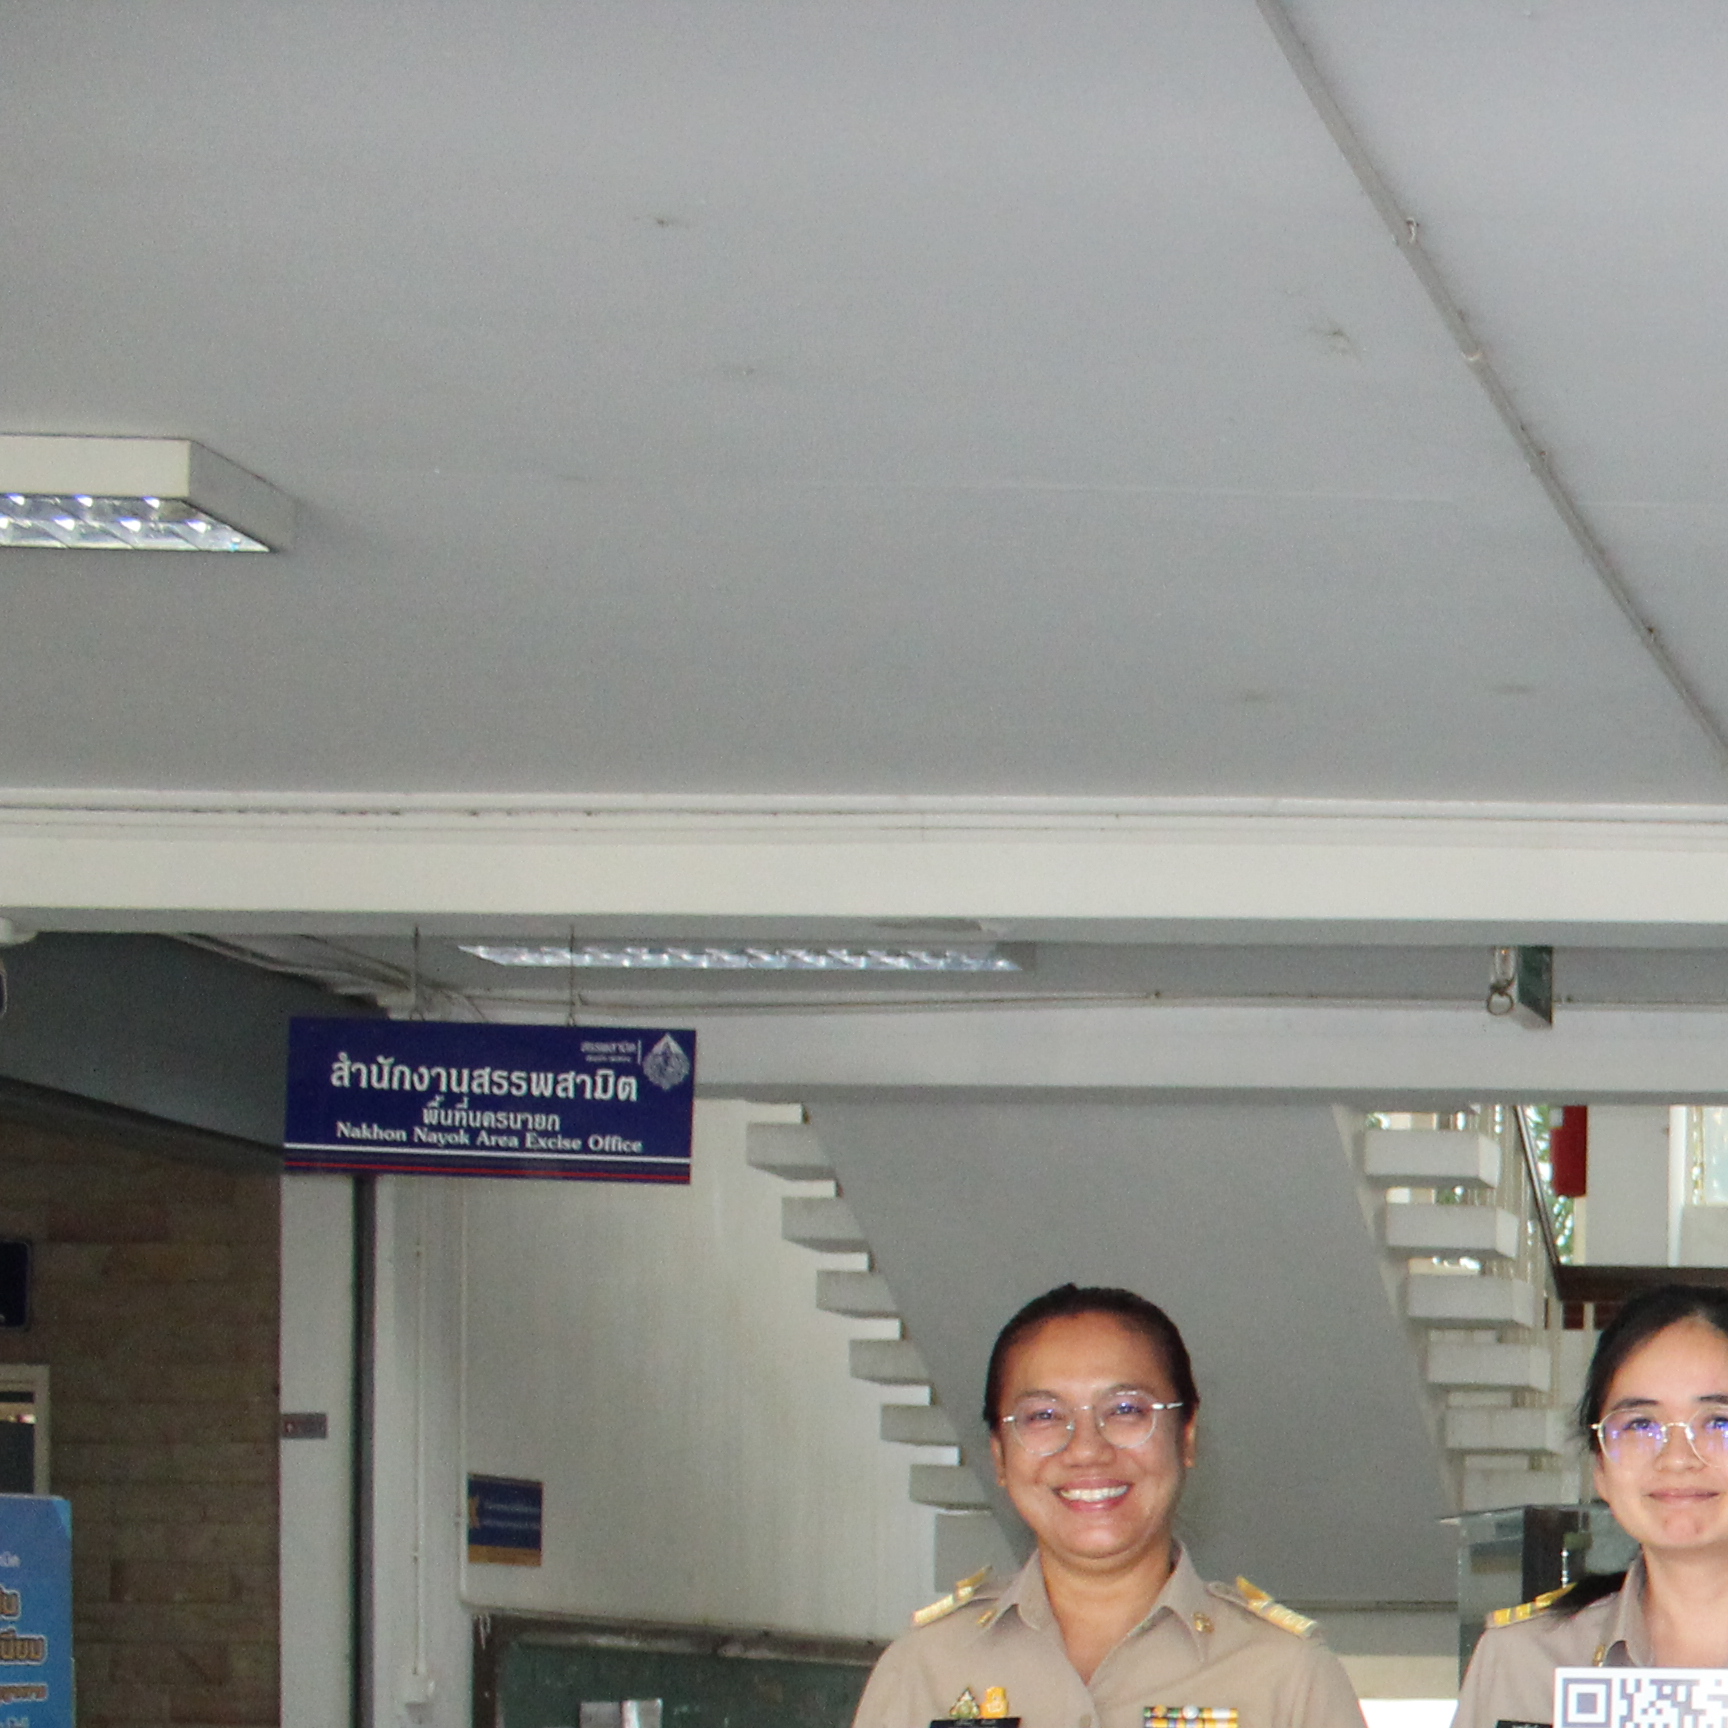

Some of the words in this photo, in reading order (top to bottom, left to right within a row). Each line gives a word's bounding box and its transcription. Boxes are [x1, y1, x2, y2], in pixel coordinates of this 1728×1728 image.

[331, 1052, 638, 1102] สำนักงานสรรพสามิต
[422, 1096, 561, 1132] พื้นที่นครนายก
[336, 1122, 407, 1142] Nakhon
[413, 1127, 470, 1147] Nayok
[476, 1130, 519, 1148] Area
[525, 1133, 582, 1150] Excise
[587, 1135, 643, 1153] Office
